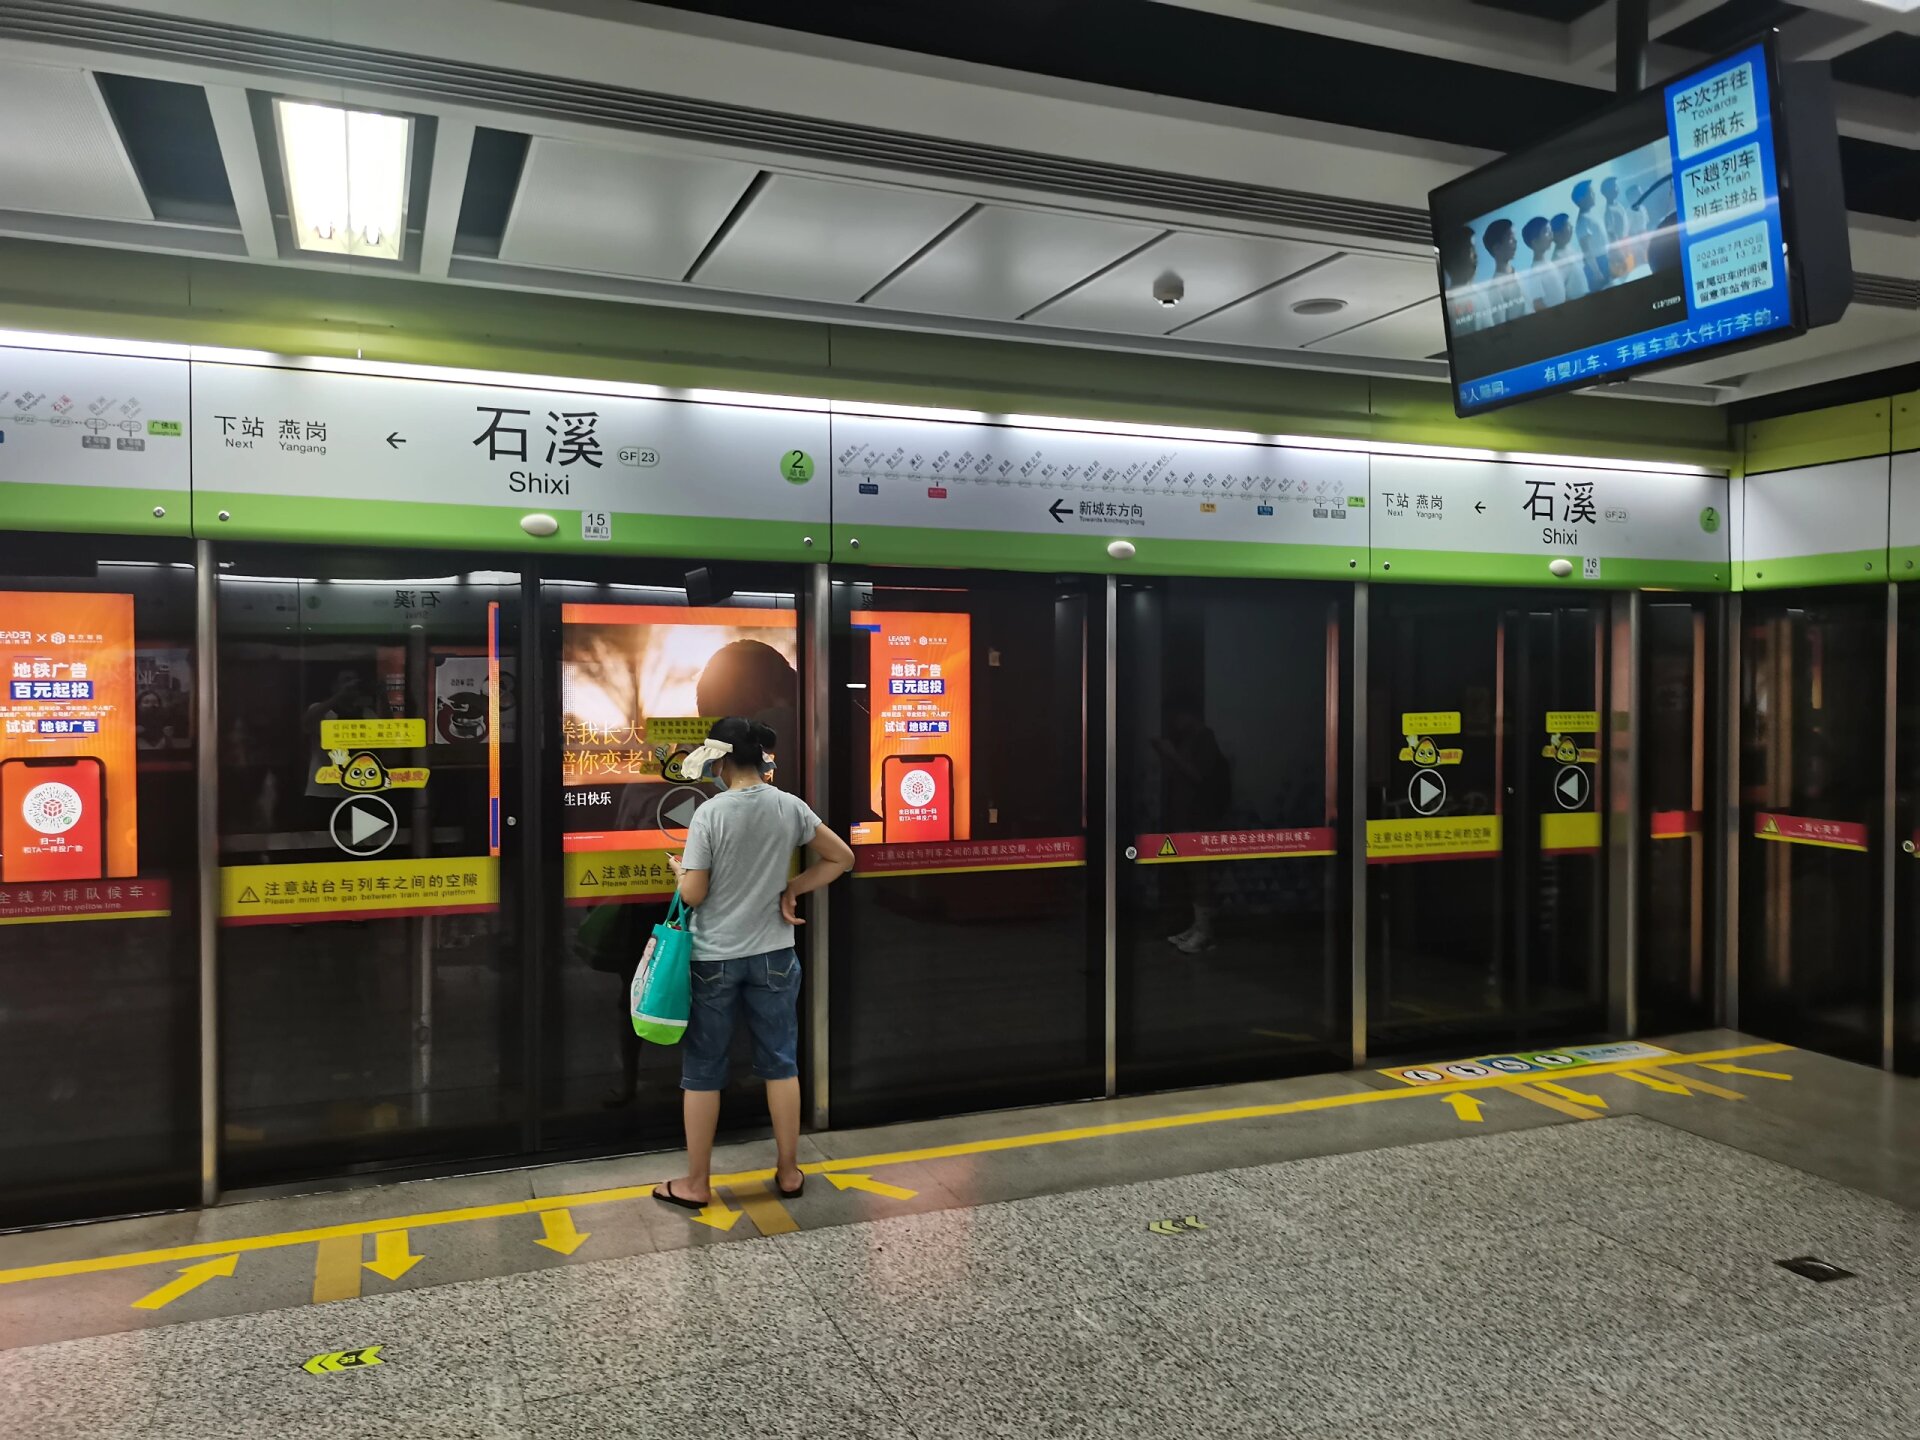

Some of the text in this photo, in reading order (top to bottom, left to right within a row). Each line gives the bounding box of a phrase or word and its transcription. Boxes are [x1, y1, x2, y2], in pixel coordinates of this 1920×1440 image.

[1676, 70, 1748, 113] 本次开往
[1691, 95, 1738, 120] Towards
[1693, 111, 1745, 147] 新城东
[1685, 149, 1755, 187] 下趟列车
[1696, 170, 1751, 198] Next Train
[1693, 186, 1757, 219] 列车进站
[214, 415, 327, 442] 下站 燕岗
[473, 406, 603, 468] 石溪
[225, 438, 327, 456] Next Yangang
[792, 450, 804, 469] 2
[509, 471, 569, 495] Shixi
[1079, 500, 1143, 518] 新城东方向
[1382, 492, 1443, 510] 下站 燕岗
[1522, 480, 1597, 524] 石溪
[587, 513, 606, 526] 15
[1416, 510, 1443, 520] Yangang
[1706, 506, 1714, 521] 2
[1542, 527, 1578, 545] Shixi
[1586, 558, 1597, 568] 16
[13, 662, 88, 679] 地铁广告
[891, 663, 942, 677] 地铁广告
[13, 682, 90, 699] 百元起投
[891, 679, 943, 694] 百元起投
[6, 720, 96, 733] 试试 地铁广告
[885, 721, 948, 733] 试试 地铁广告
[564, 791, 612, 806] 生日快乐
[264, 873, 479, 897] 注意站台与列车之间的空隙
[602, 880, 628, 888] Please
[264, 897, 295, 905] Please
[298, 896, 320, 904] mind
[341, 895, 358, 903] gap
[361, 892, 398, 901] between
[401, 891, 420, 899] train
[442, 888, 476, 898] platform
